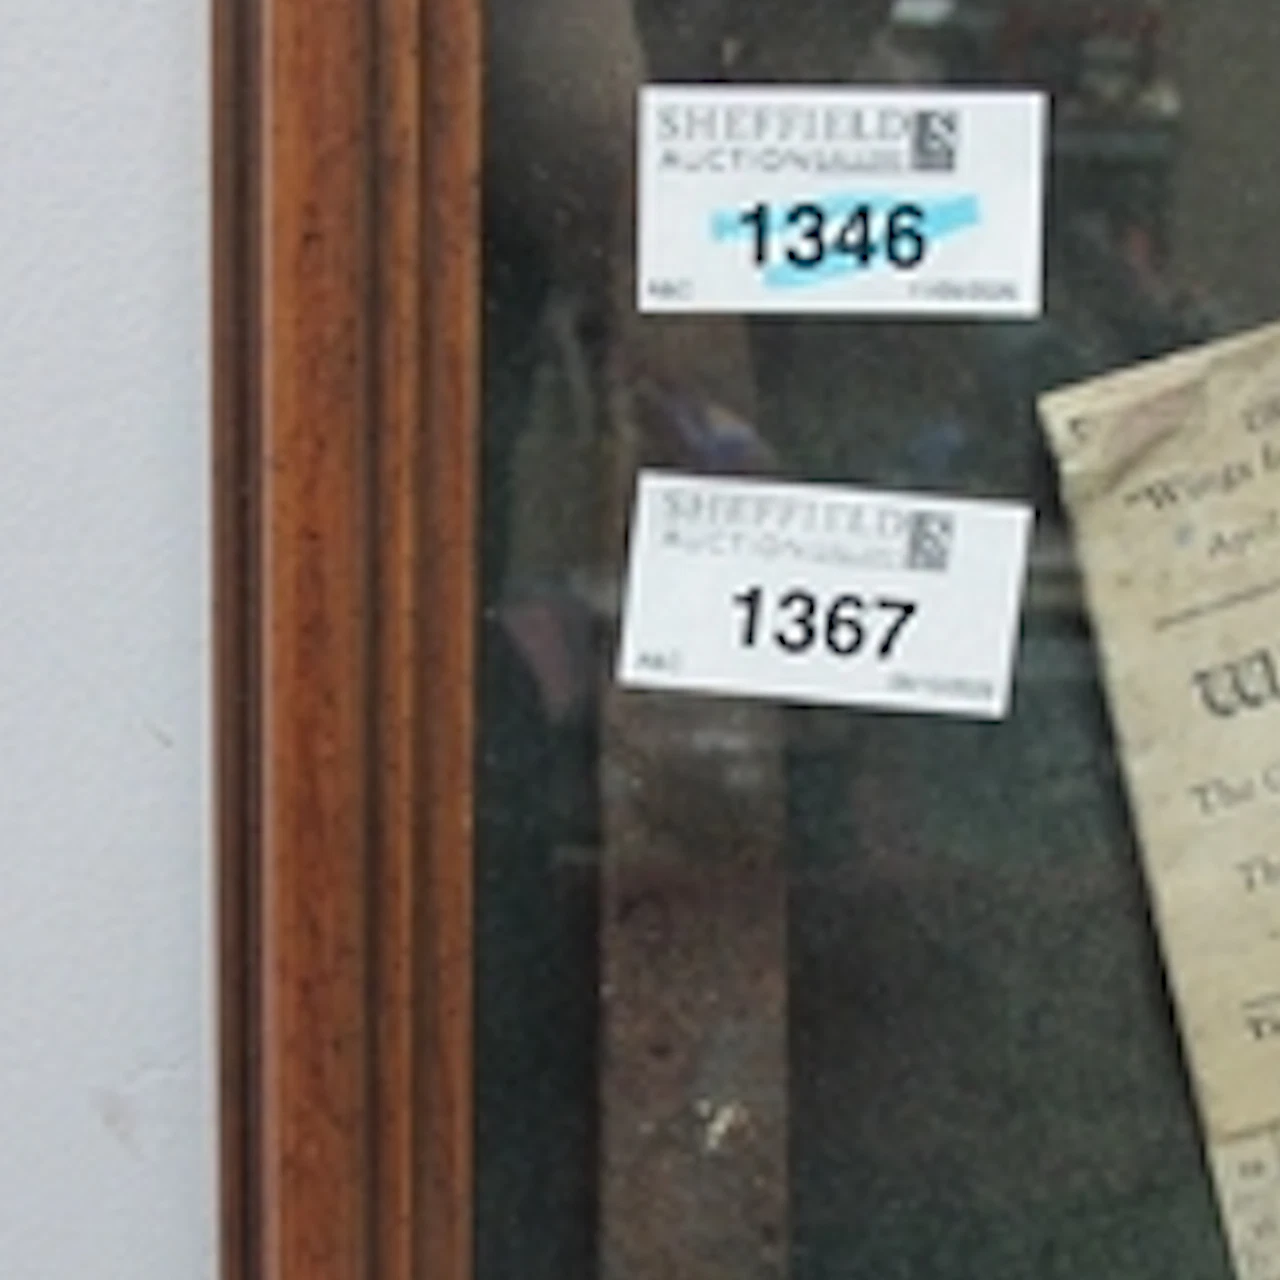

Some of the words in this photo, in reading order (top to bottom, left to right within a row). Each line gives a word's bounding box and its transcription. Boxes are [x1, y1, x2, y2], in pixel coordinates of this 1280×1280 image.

[657, 108, 908, 141] SHEFFIELD
[738, 201, 925, 270] 1346
[661, 492, 907, 538] SHEFFIELD
[732, 583, 918, 662] 1367
[1189, 772, 1256, 815] The
